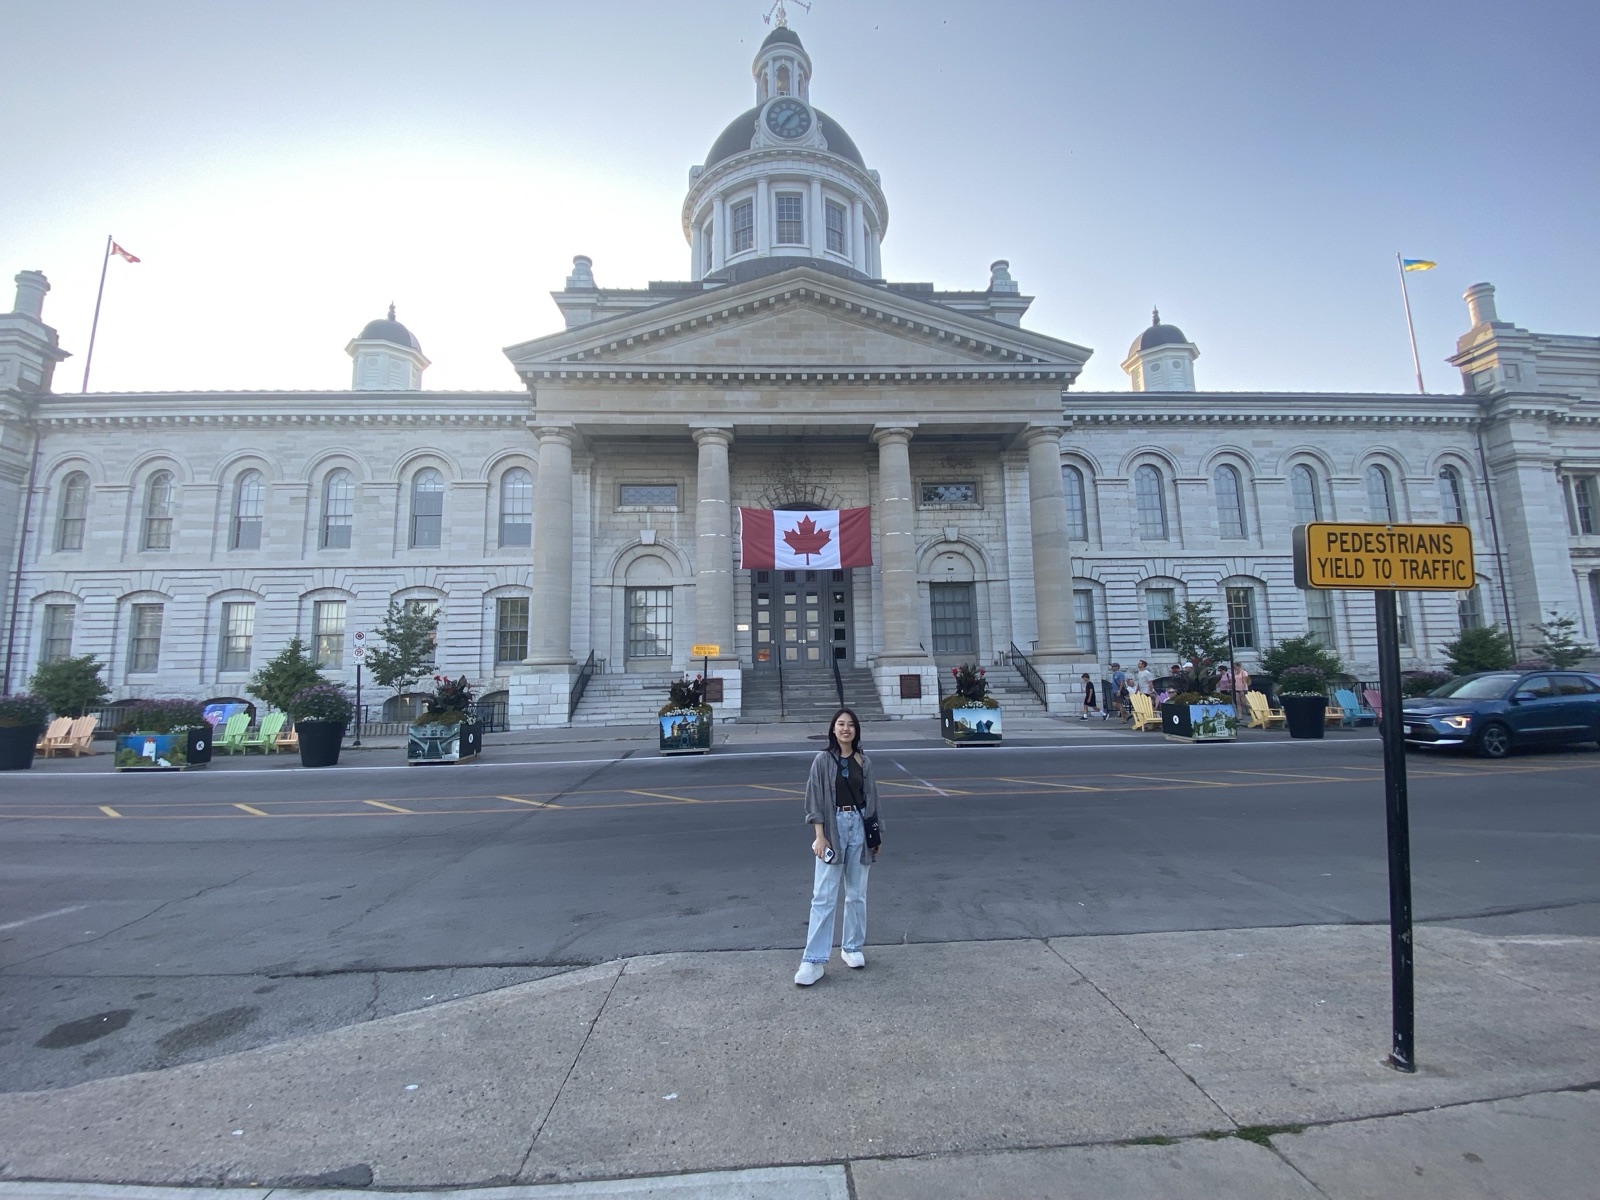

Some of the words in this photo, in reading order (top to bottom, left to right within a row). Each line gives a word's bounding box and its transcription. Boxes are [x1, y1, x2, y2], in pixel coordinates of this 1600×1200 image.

[1327, 532, 1453, 554] PEDESTRIANS
[1317, 557, 1364, 579] YIELD
[1372, 558, 1392, 579] TO
[1400, 559, 1466, 581] TRAFFIC
